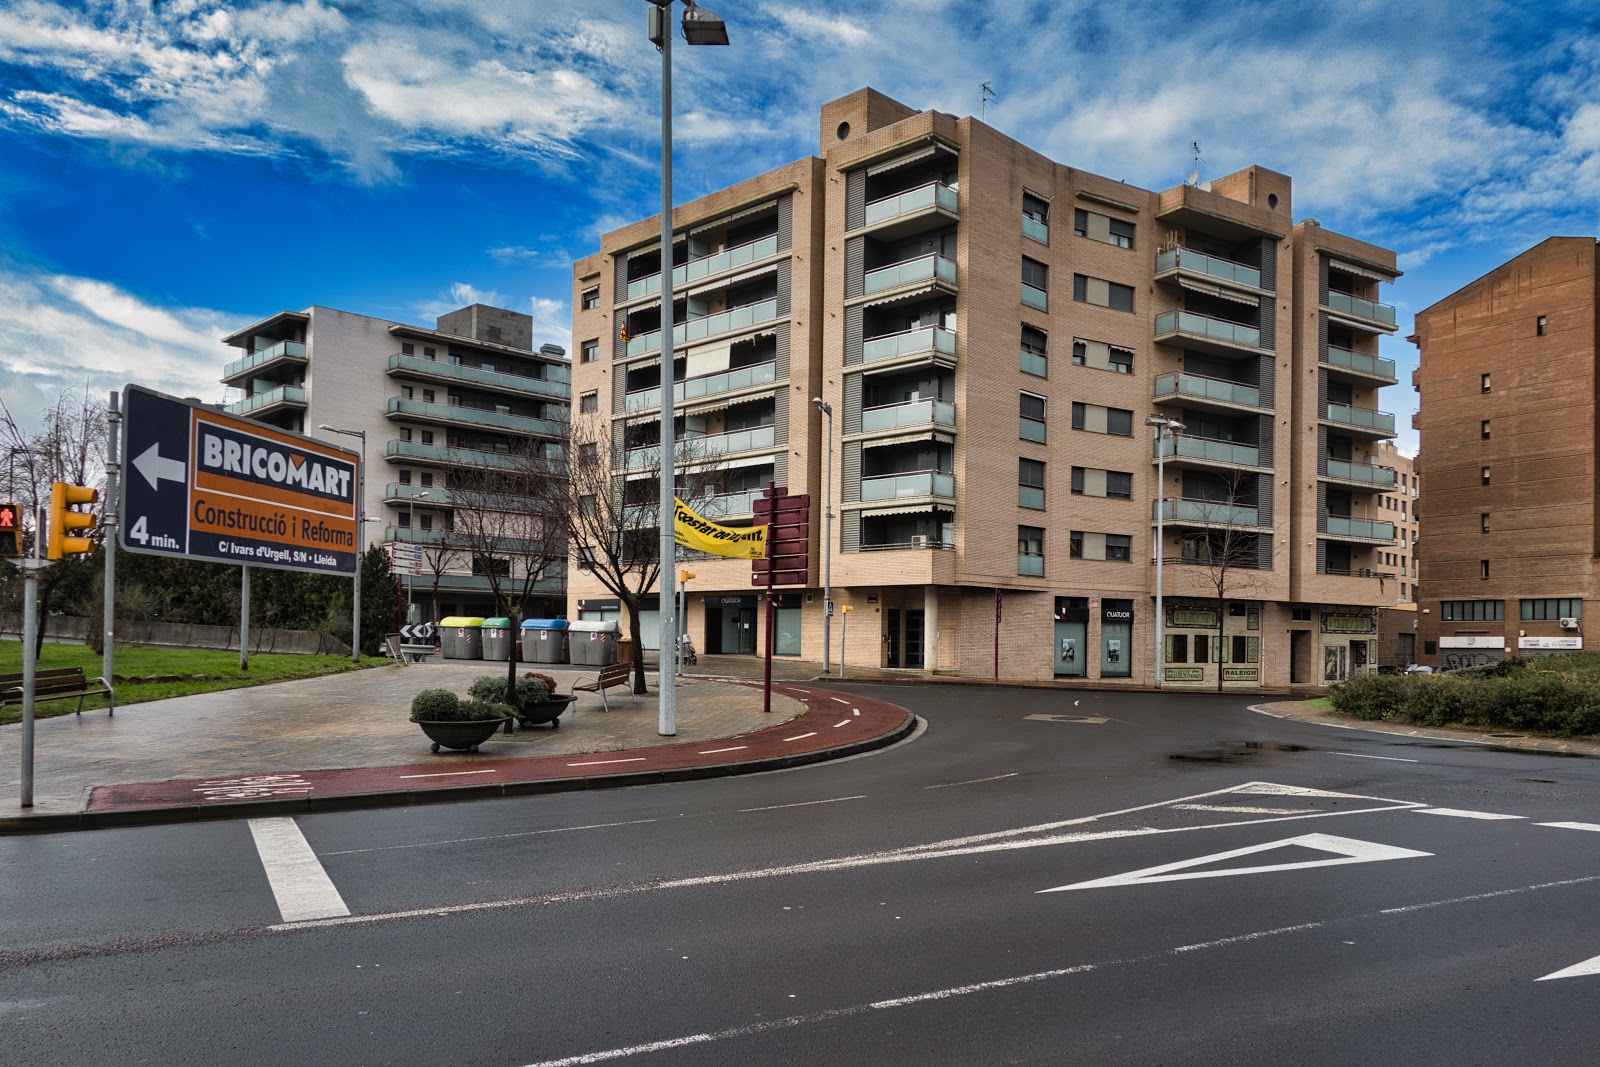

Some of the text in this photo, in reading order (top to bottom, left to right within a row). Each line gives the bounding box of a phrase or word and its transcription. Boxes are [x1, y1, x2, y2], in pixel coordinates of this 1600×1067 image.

[204, 433, 350, 498] BRICOMART
[130, 515, 180, 549] 4 min.
[194, 500, 353, 547] Construcció i Reforma
[218, 541, 337, 566] C/ Ivars d'Urgell, S/N Lleida
